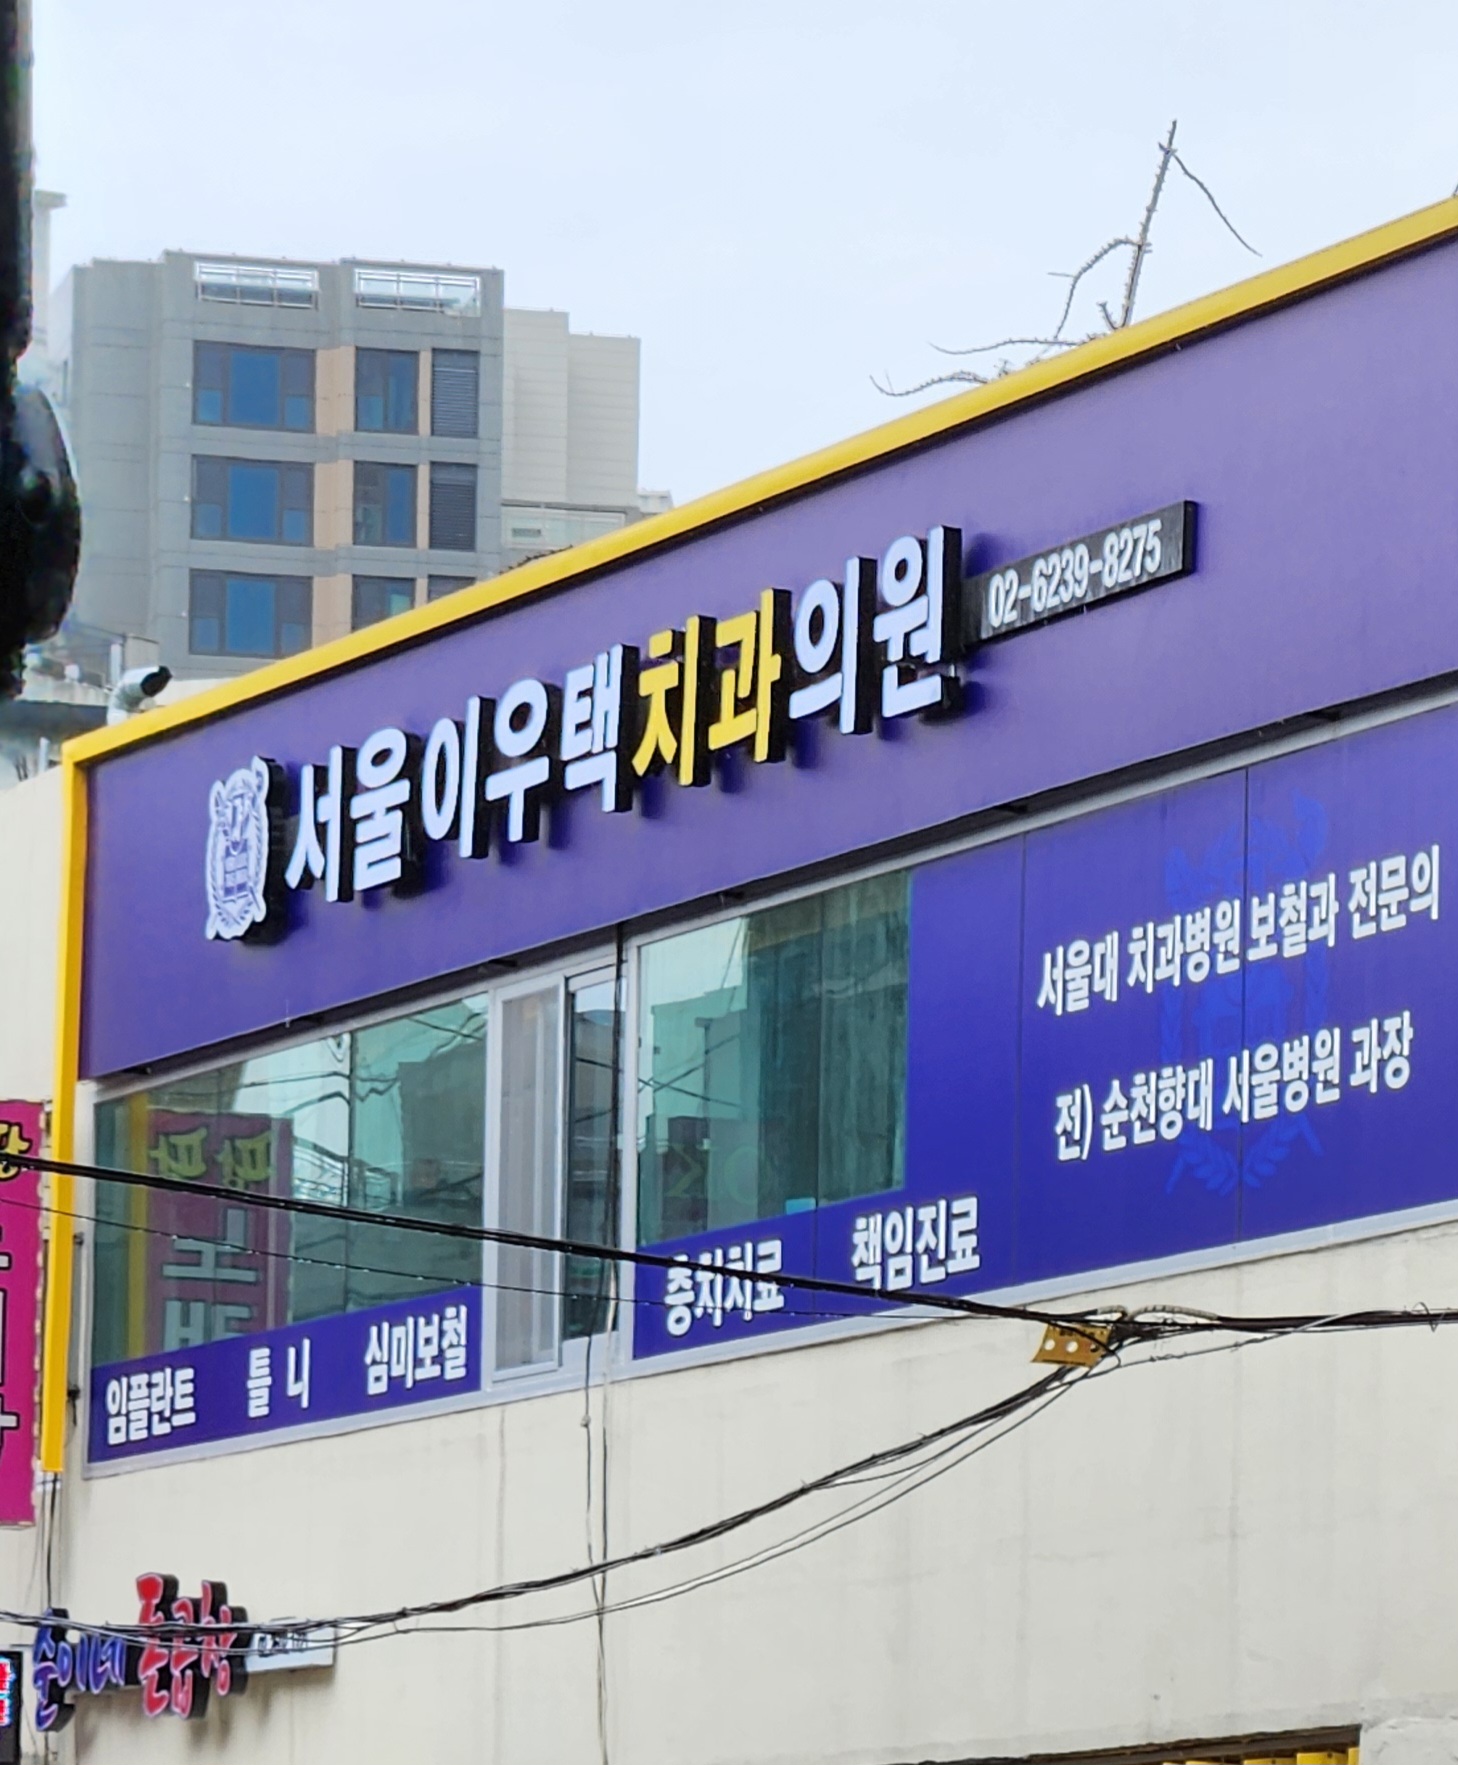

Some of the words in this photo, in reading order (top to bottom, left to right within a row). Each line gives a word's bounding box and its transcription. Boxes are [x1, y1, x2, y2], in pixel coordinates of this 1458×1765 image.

[988, 519, 1162, 627] 02-6239-8275
[1036, 930, 1119, 1016] 서울대
[1126, 898, 1241, 993] 치과병원
[1246, 872, 1339, 961] 보철과
[1347, 844, 1440, 940] 전문의
[1055, 1083, 1093, 1161] 전)
[1100, 1058, 1213, 1151] 순천향대
[1222, 1027, 1341, 1126] 서울병원
[1350, 1010, 1414, 1094] 과장
[851, 1196, 982, 1292] 책임진료
[106, 1367, 197, 1446] 임플란트
[364, 1305, 469, 1395] 심미보철
